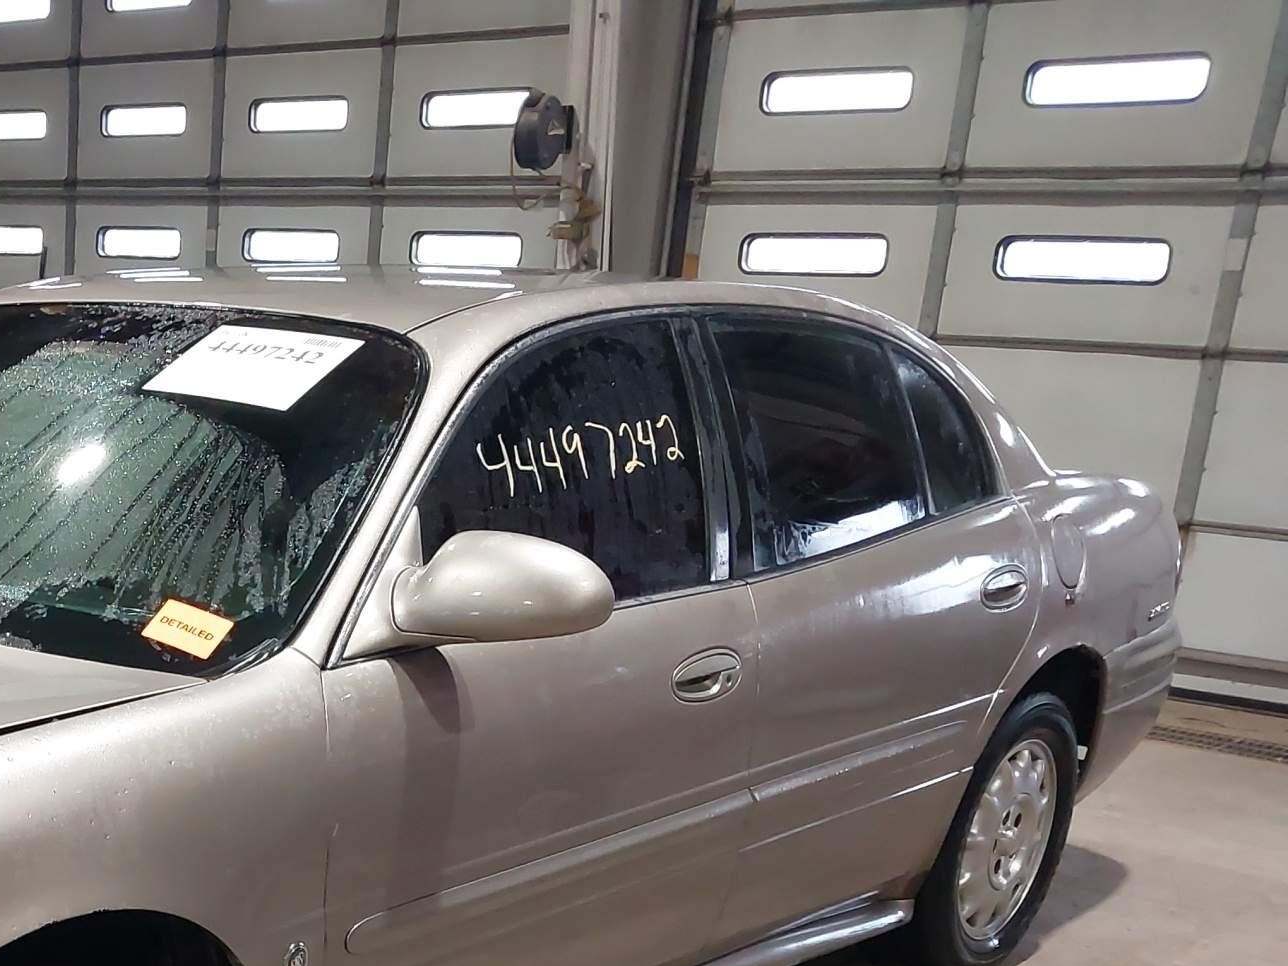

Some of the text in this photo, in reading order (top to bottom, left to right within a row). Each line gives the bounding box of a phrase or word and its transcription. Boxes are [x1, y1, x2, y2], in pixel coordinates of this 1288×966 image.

[208, 340, 324, 364] 44497242
[476, 415, 685, 497] 44497242
[159, 616, 215, 641] DETAILED
